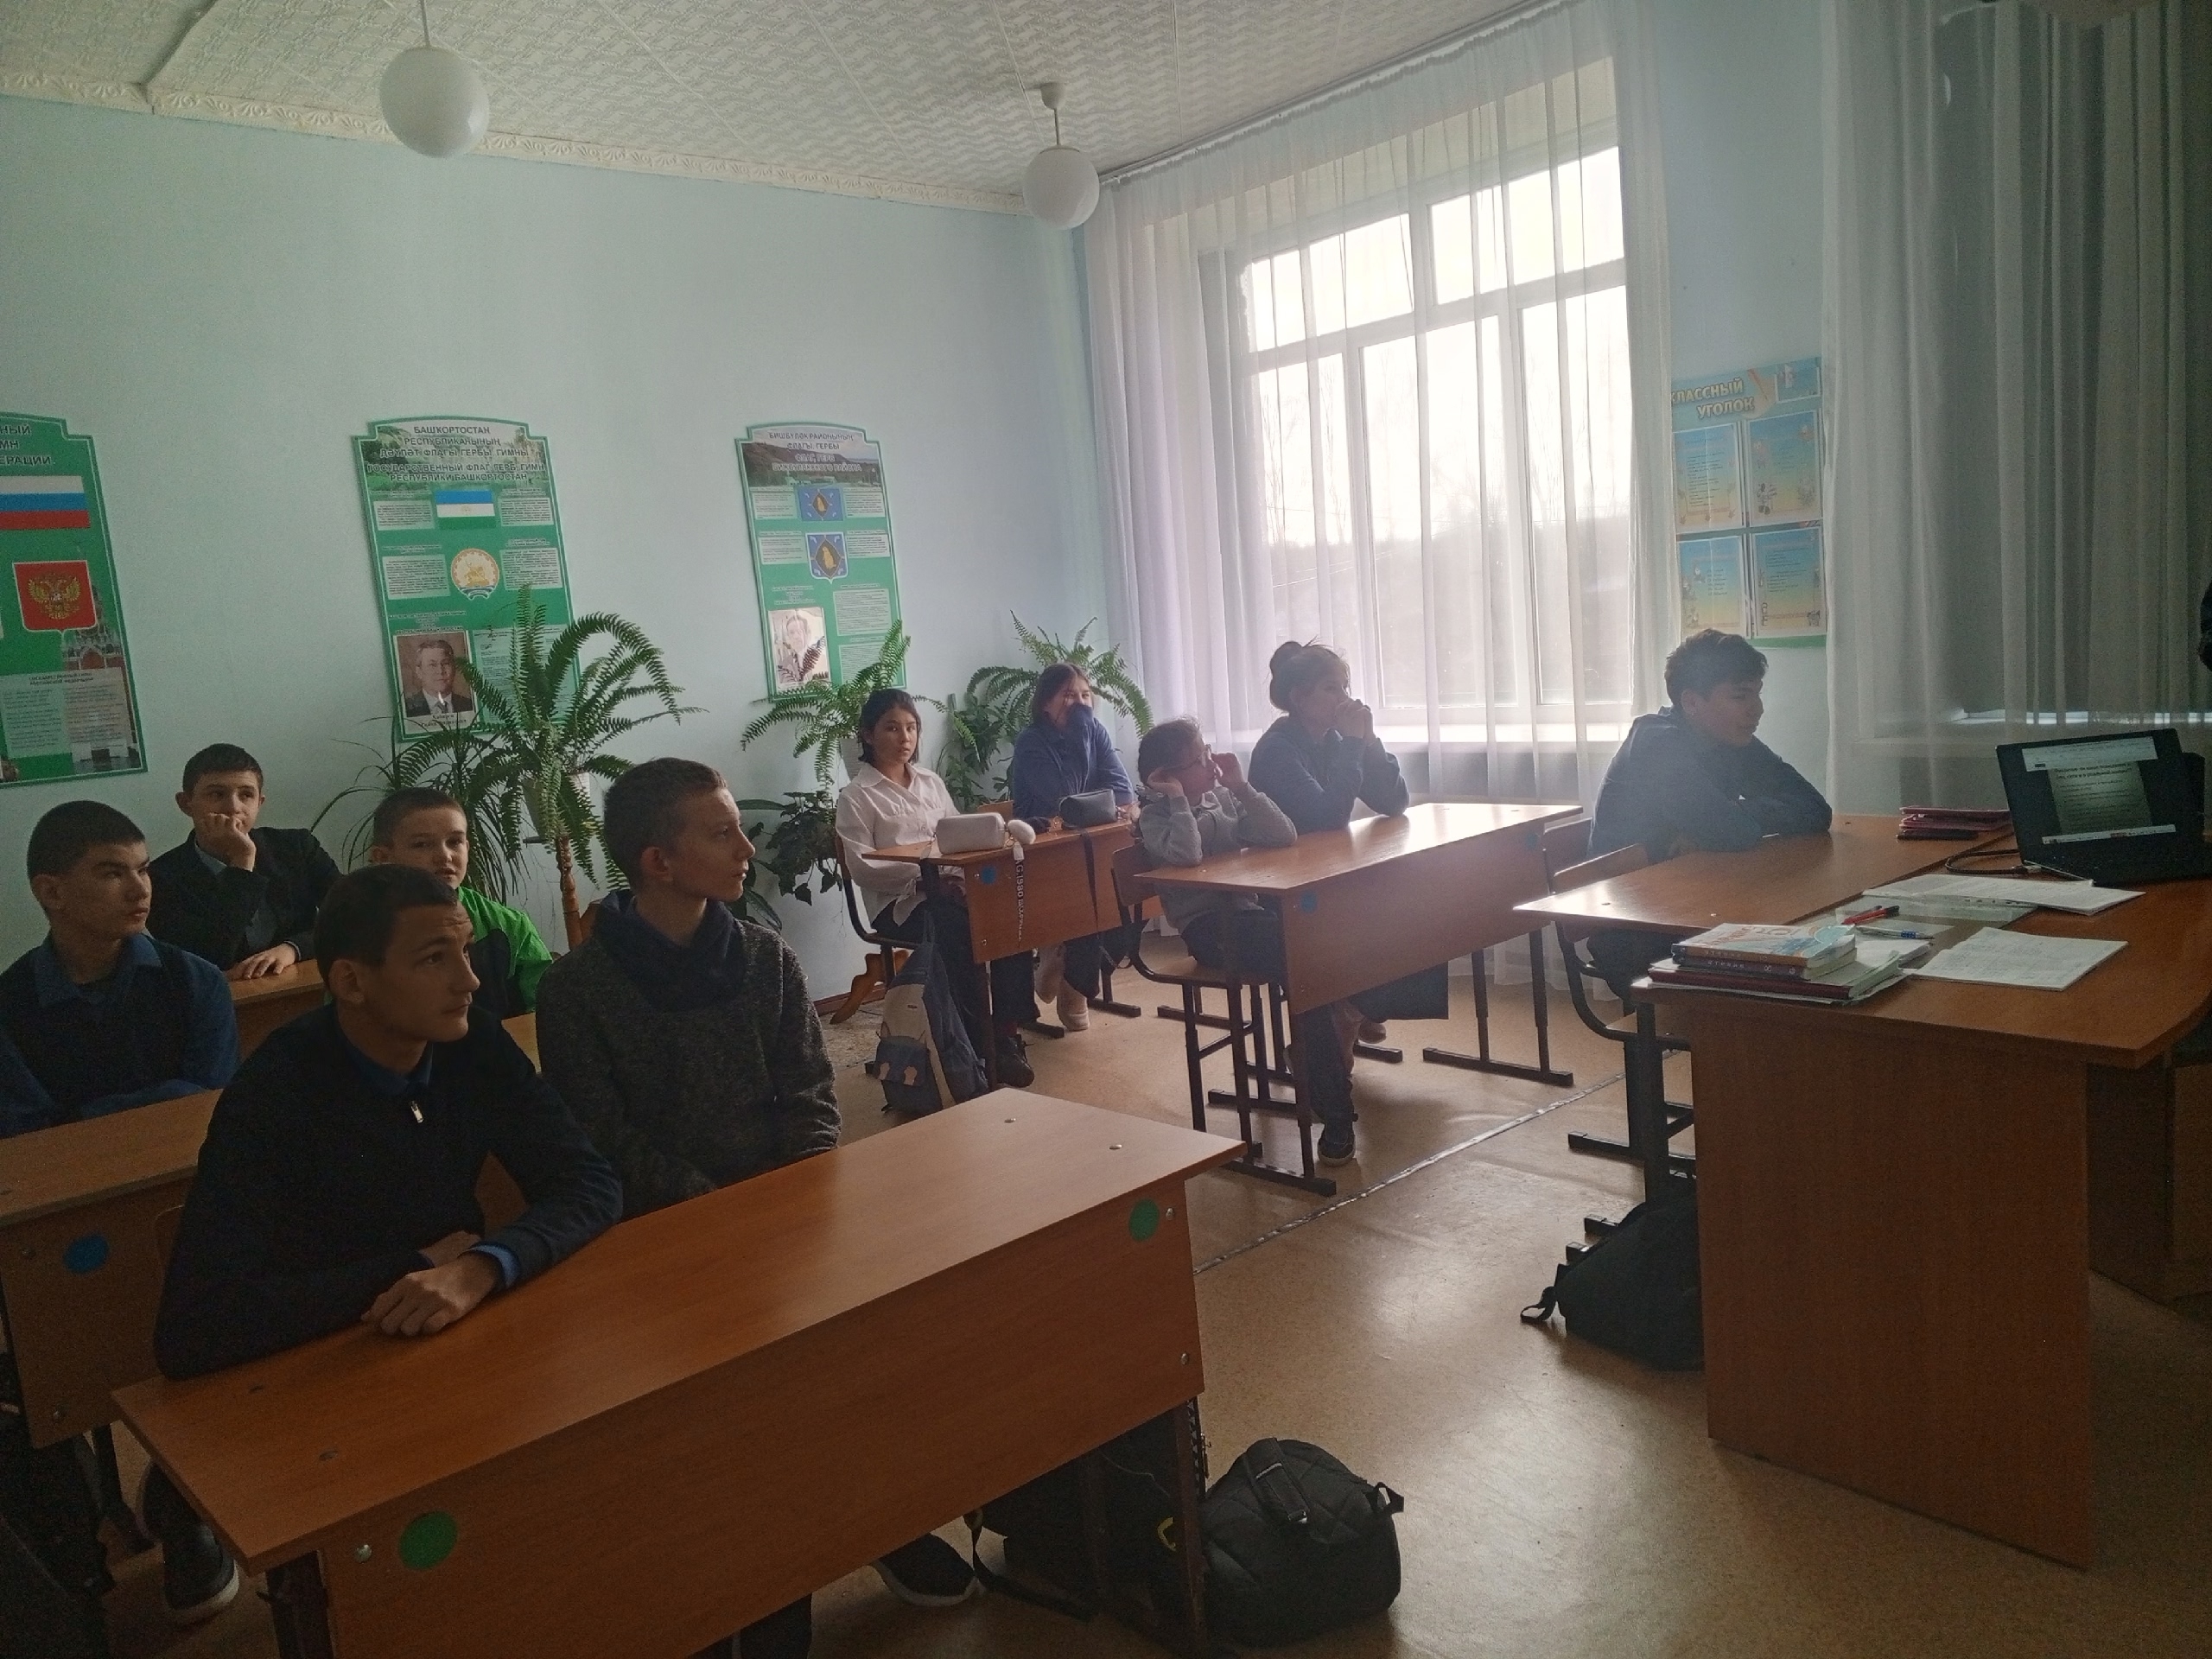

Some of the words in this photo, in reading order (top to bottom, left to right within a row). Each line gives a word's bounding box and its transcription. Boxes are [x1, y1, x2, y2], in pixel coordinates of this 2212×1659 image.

[1696, 397, 1755, 419] УГОЛОК
[367, 462, 463, 473] ГОСУДАРСТВЕННЫЙ
[391, 474, 451, 482] РЕСПУБЛИКИ
[454, 474, 527, 482] БАШКОРТОСТАН
